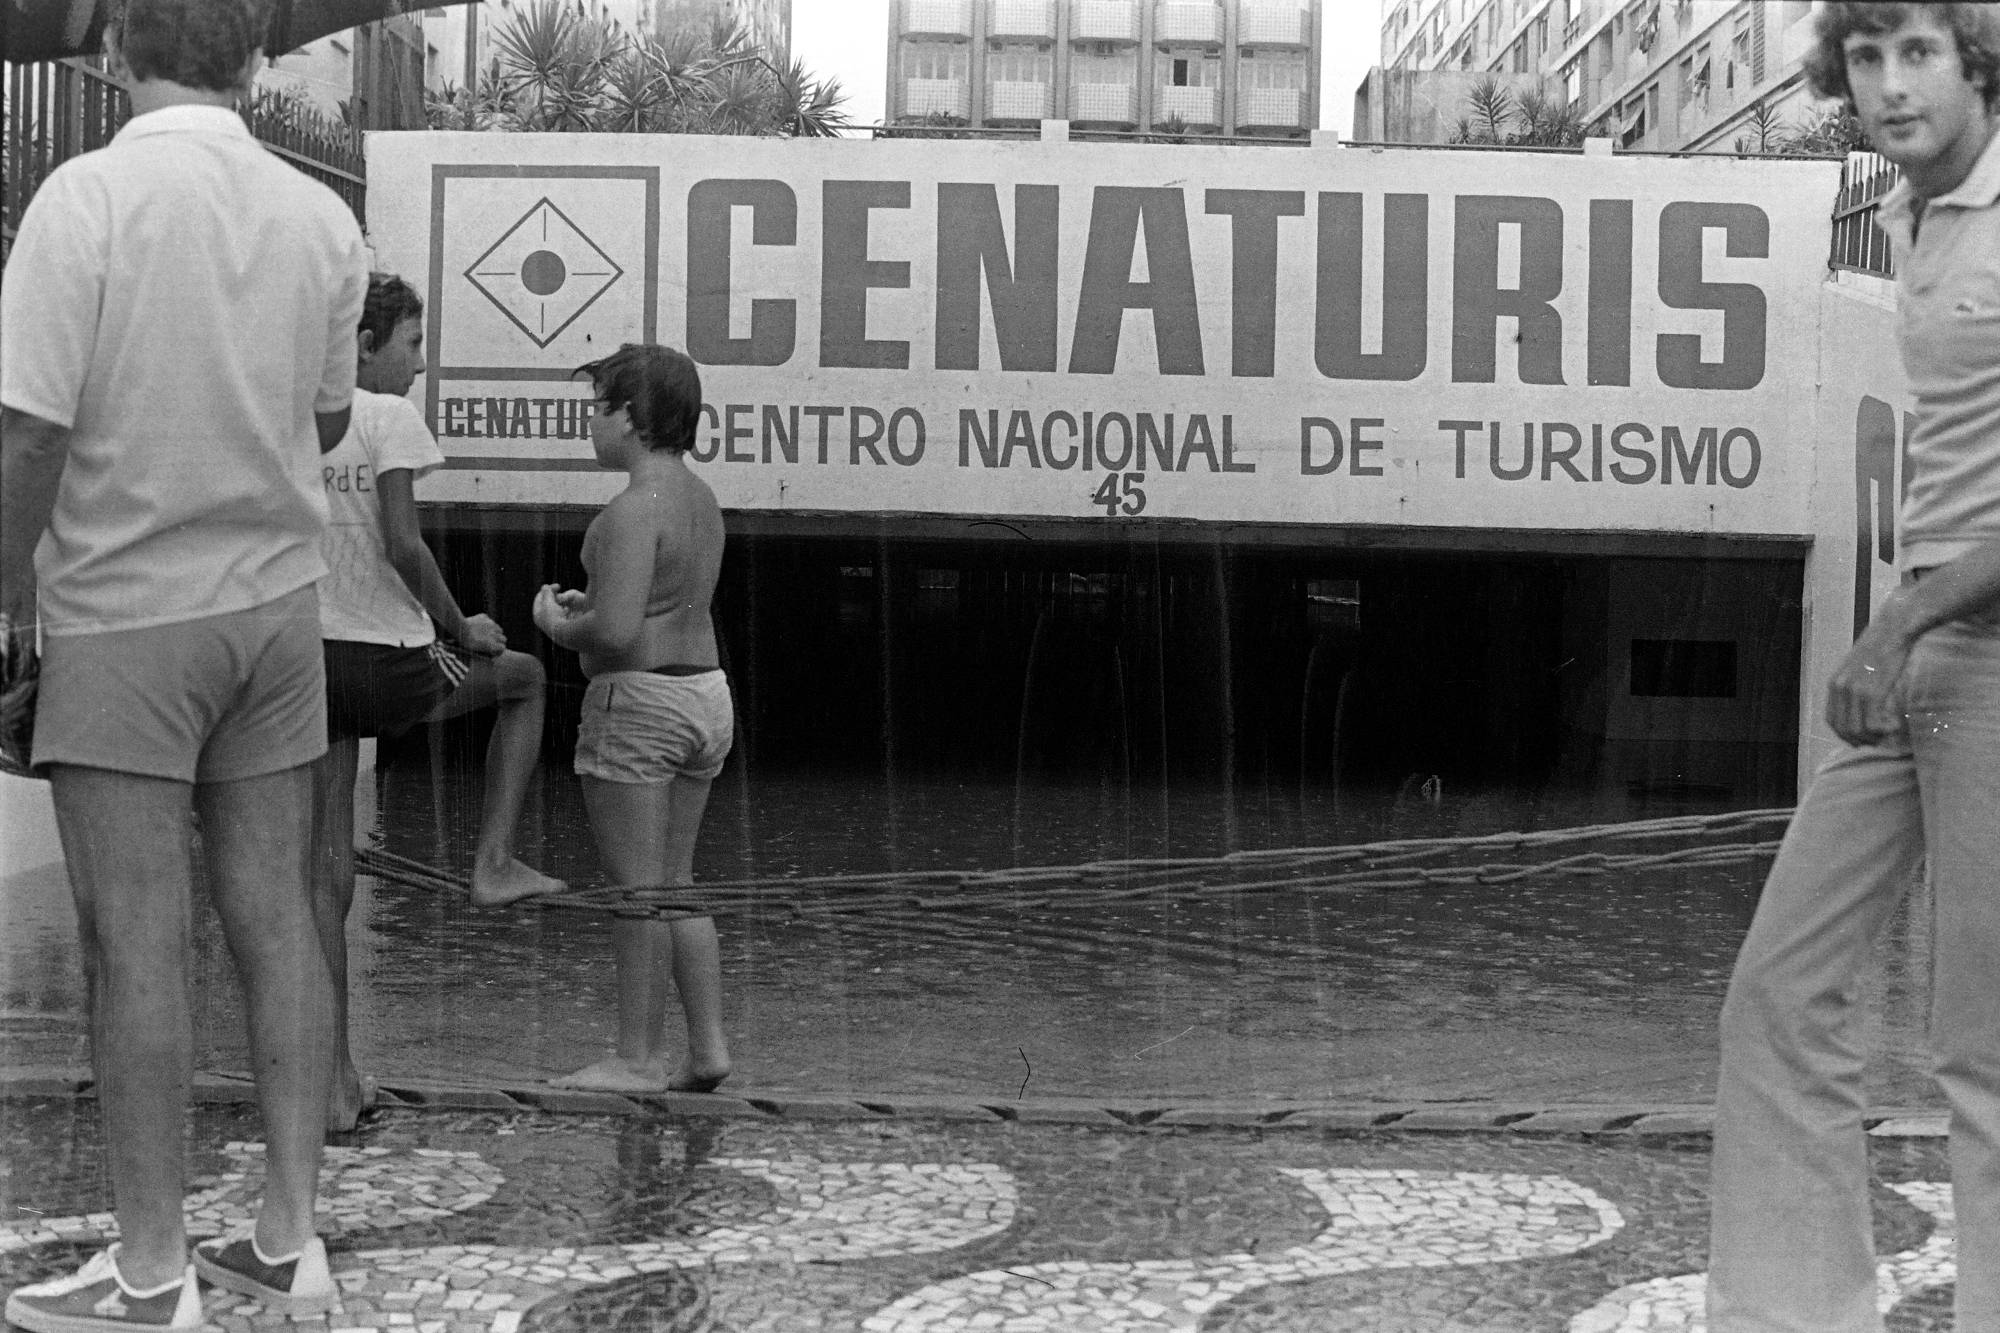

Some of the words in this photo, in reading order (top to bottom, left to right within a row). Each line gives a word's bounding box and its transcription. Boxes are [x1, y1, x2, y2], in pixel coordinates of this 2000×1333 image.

[686, 178, 1770, 390] CENATURIS
[690, 403, 926, 466] CENTRO
[958, 408, 1256, 474] NACIONAL
[1300, 416, 1385, 477] DE
[1437, 419, 1762, 489] TURISMO
[1092, 473, 1147, 517] 45
